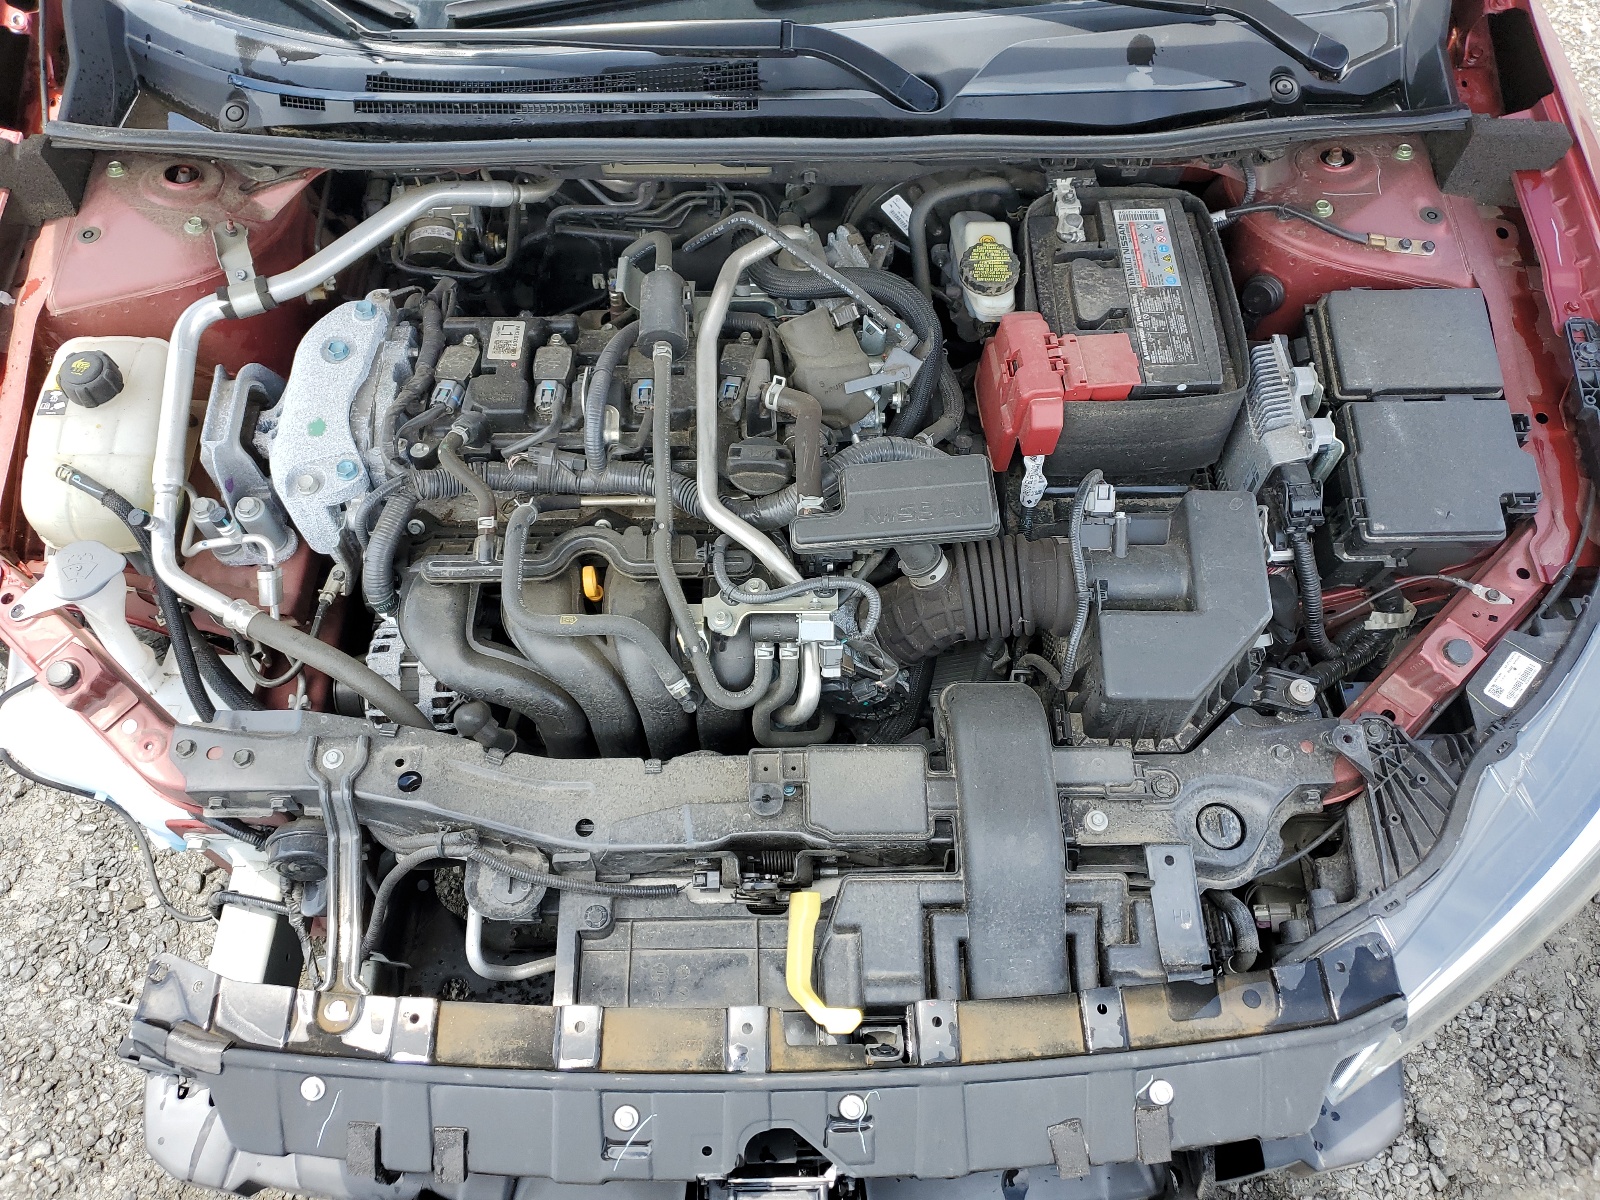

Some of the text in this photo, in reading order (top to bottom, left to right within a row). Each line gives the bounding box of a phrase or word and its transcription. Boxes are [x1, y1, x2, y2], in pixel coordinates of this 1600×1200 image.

[1117, 223, 1130, 255] NISSAN
[1123, 256, 1136, 286] RENAULT
[501, 324, 515, 336] L1
